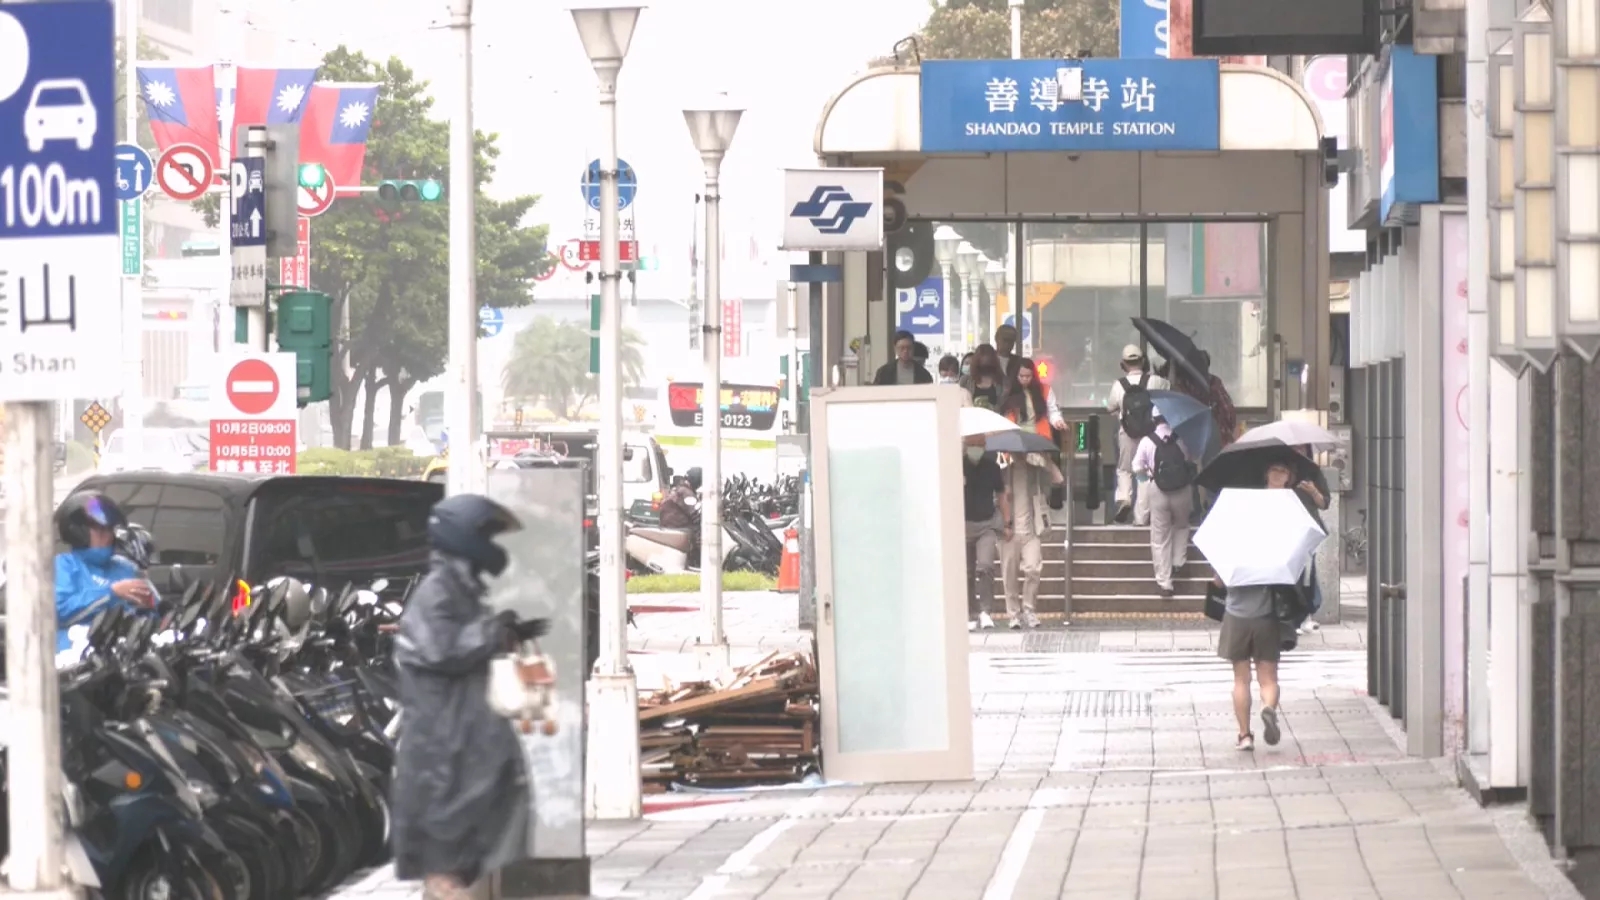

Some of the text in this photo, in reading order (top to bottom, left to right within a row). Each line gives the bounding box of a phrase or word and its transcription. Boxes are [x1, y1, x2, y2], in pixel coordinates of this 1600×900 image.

[984, 76, 1156, 112] 善導寺站
[965, 121, 1176, 136] SHANDAO TEMPLE STATION
[1, 162, 102, 228] 100m
[0, 262, 77, 335] 山
[896, 287, 917, 327] P
[13, 353, 77, 375] Shan
[215, 422, 291, 434] 10月2日09:00
[694, 412, 752, 428] E-0123
